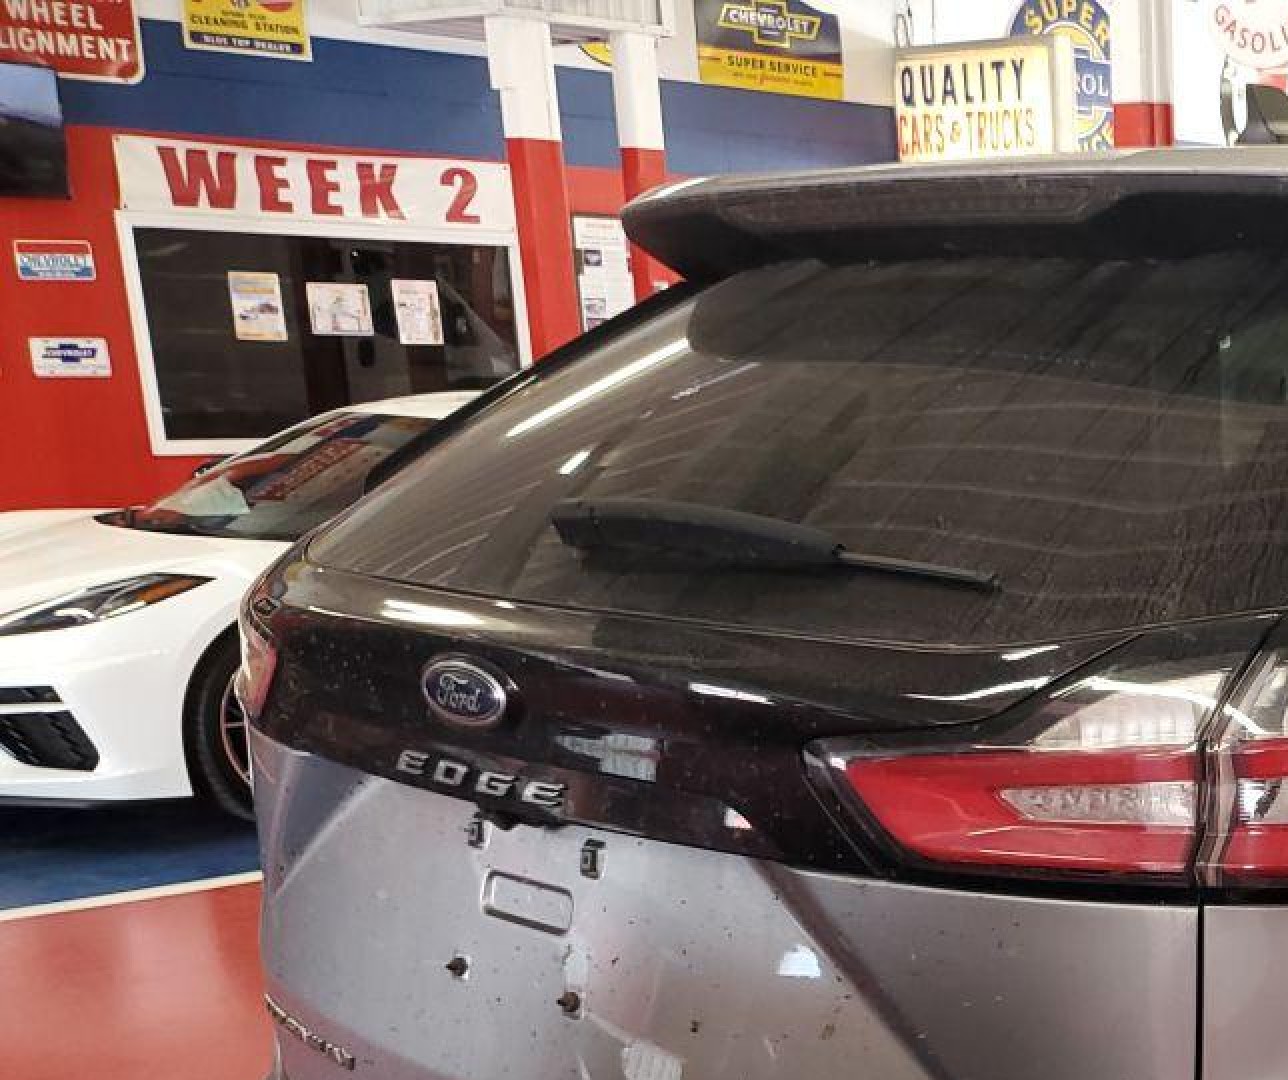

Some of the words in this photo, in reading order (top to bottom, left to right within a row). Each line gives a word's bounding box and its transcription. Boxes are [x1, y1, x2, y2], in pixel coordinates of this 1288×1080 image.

[5, 0, 103, 31] WHEEL
[728, 8, 810, 34] CHEVROLET
[1024, 0, 1110, 46] SUPER
[727, 55, 765, 70] SUPER
[769, 59, 817, 79] SERVICE
[900, 57, 1025, 108] QUALITY
[899, 112, 946, 157] CARS
[965, 107, 1036, 152] TRUCKS
[157, 145, 406, 221] WEEK
[439, 167, 481, 225] 2
[437, 672, 482, 713] Ford
[396, 749, 567, 806] EDGE
